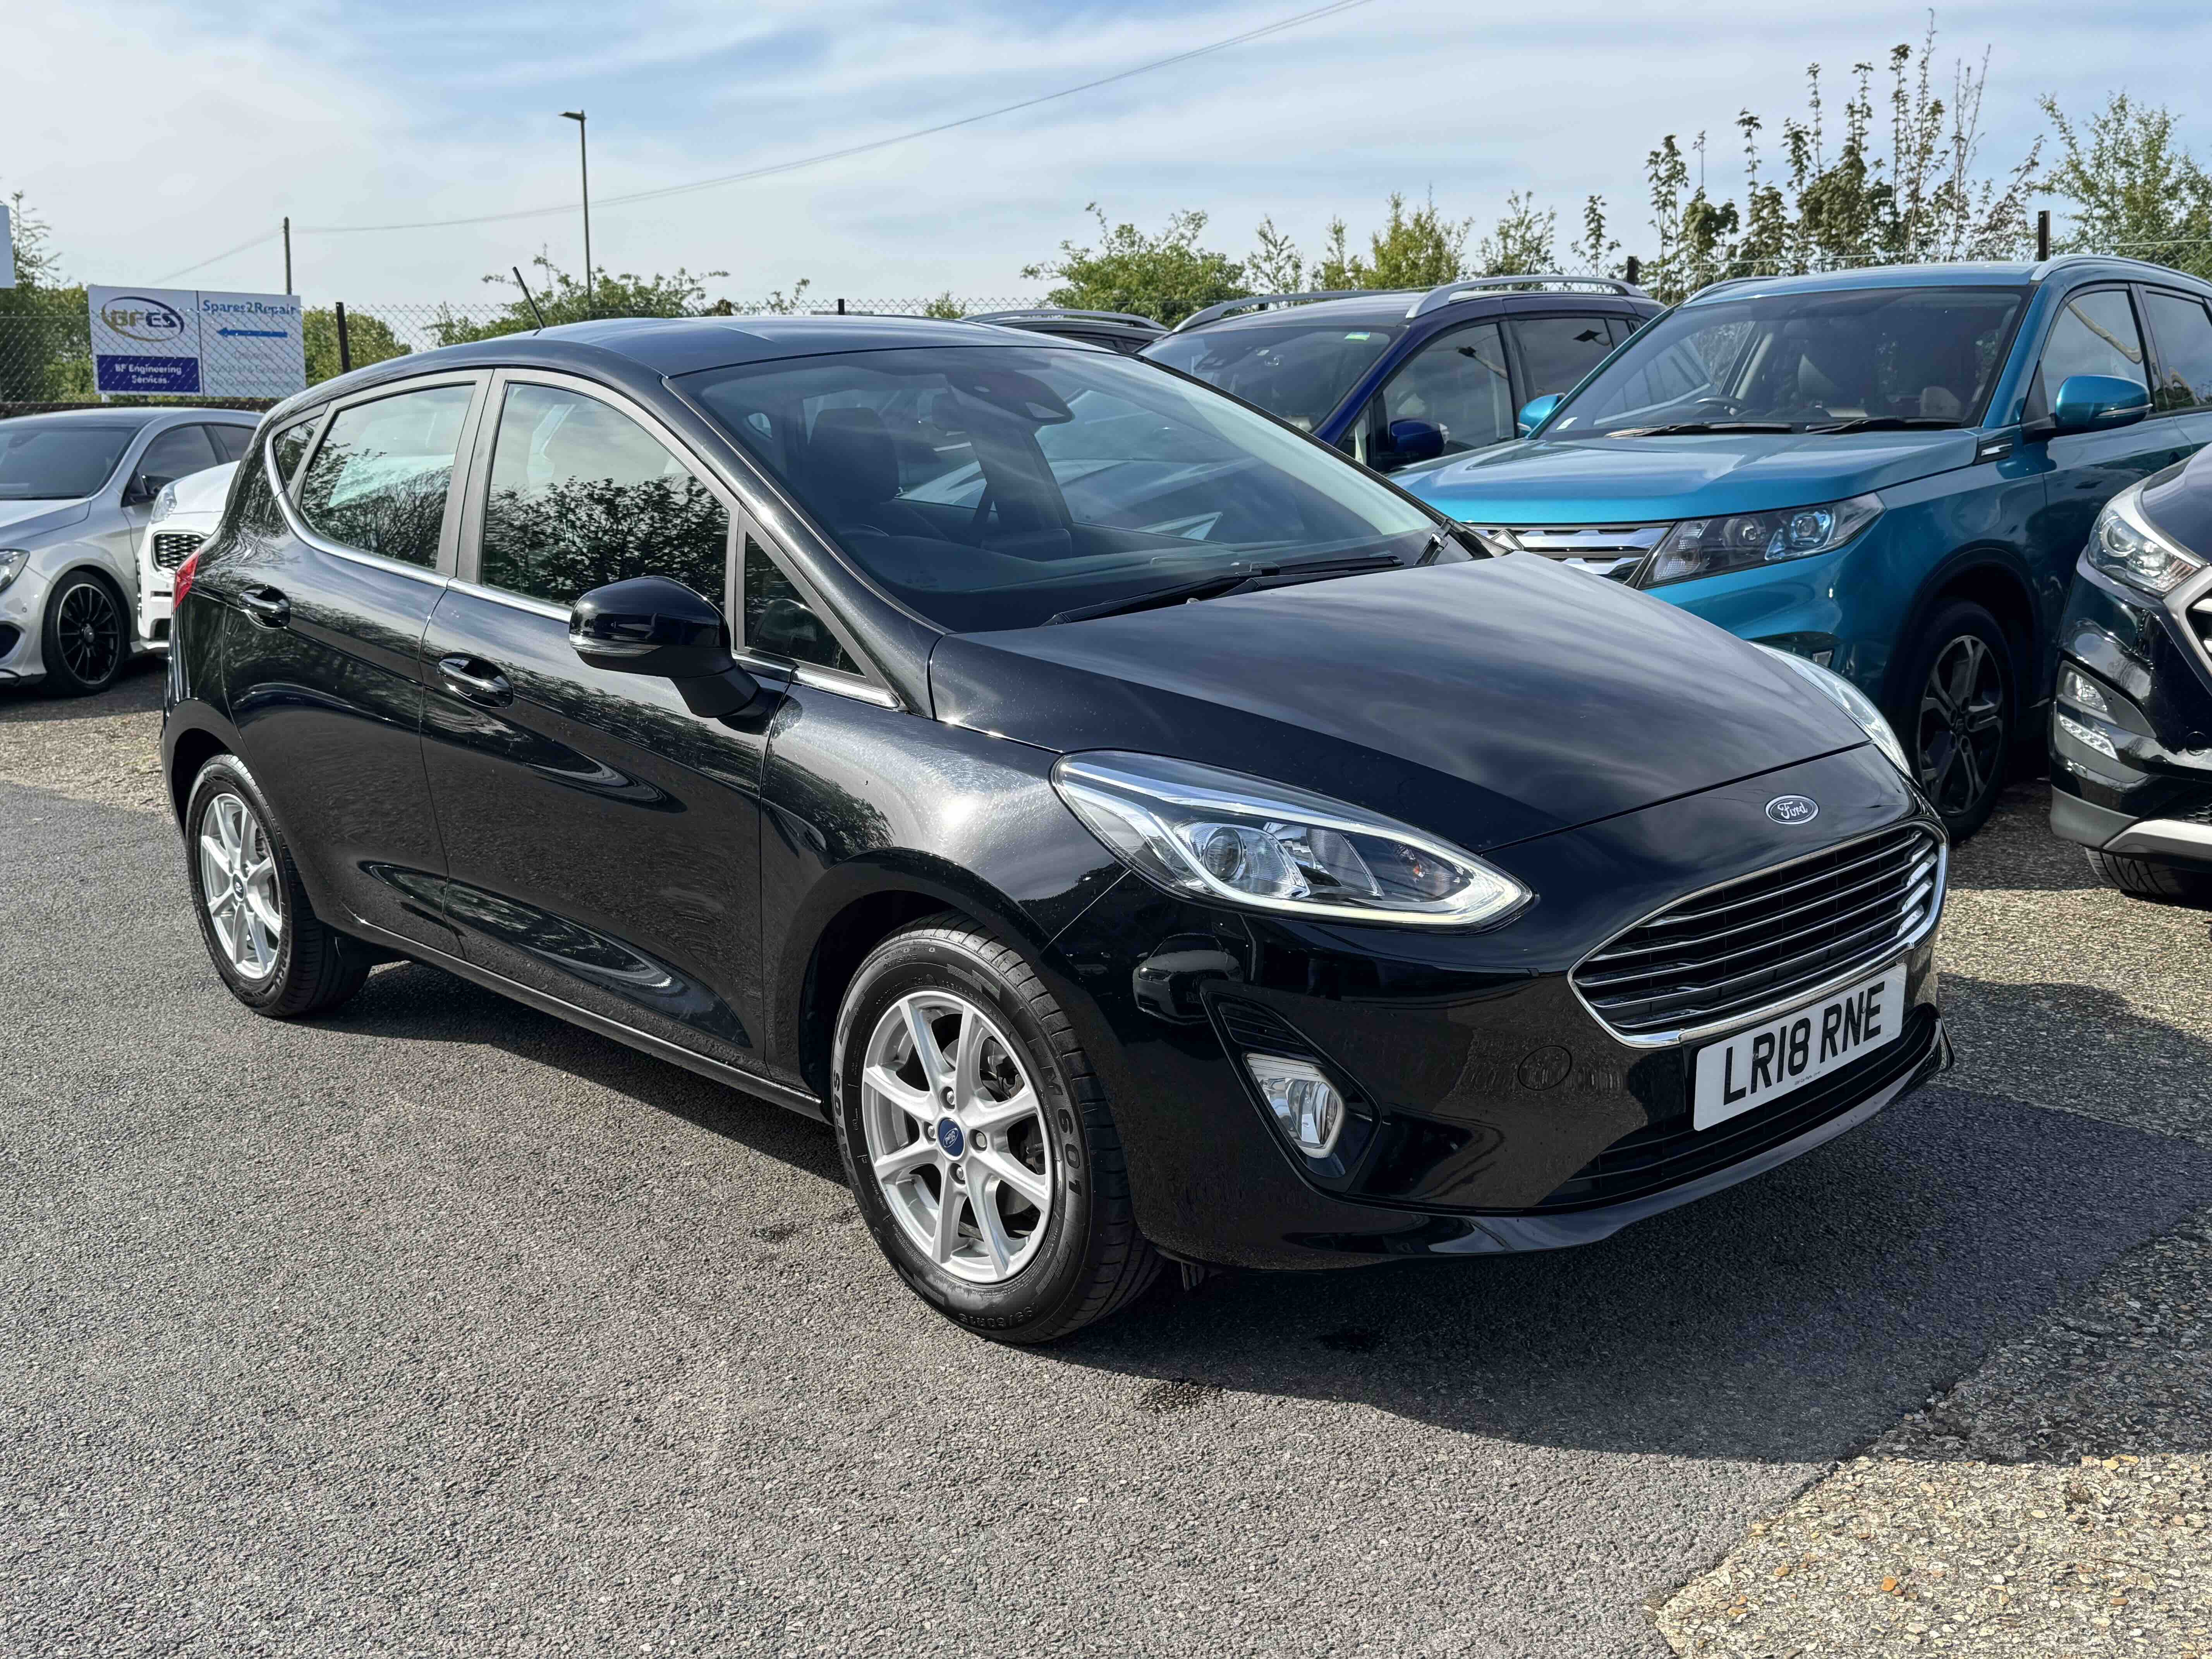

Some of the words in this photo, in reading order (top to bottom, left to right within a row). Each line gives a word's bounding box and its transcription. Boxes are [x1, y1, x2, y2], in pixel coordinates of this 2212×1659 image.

[203, 299, 296, 317] Spares2Repair
[111, 310, 177, 328] BFES
[115, 364, 126, 372] BF
[129, 364, 182, 375] Engineering
[1777, 801, 1808, 819] Ford
[883, 953, 917, 970] OUTSIDE
[1723, 1017, 1811, 1106] LR18
[1819, 981, 1885, 1063] RNE
